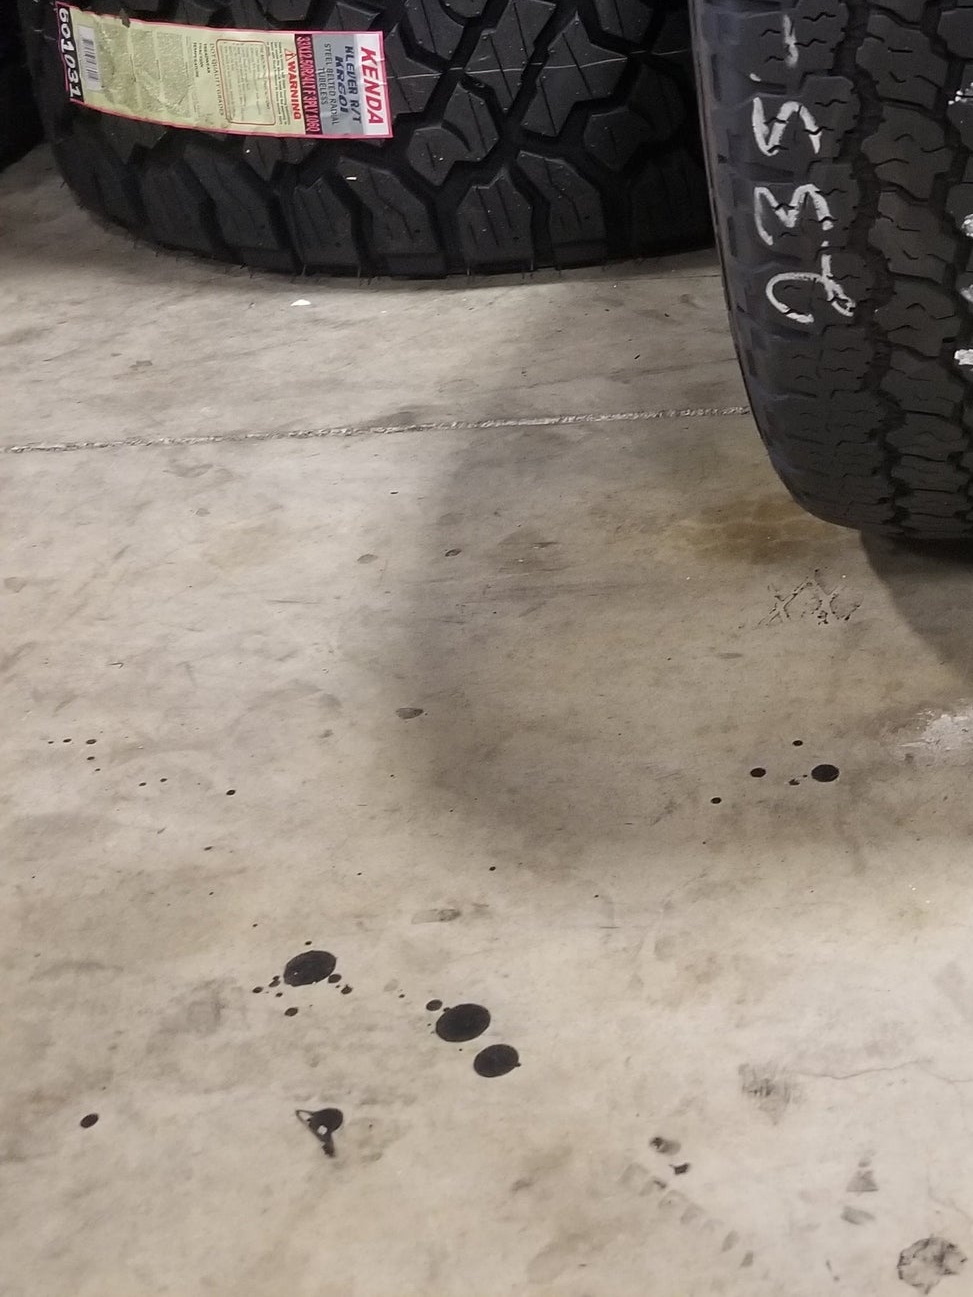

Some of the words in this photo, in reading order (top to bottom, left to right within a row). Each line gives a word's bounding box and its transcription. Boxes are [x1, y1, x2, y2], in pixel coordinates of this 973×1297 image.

[58, 8, 82, 97] 601031
[324, 43, 333, 66] STEEL
[345, 46, 359, 95] KLEVER
[287, 61, 302, 120] WARNING
[318, 67, 328, 105] TUBELESS
[326, 68, 336, 97] BELTED
[360, 47, 384, 124] KENDA
[329, 99, 339, 125] RADIAL
[350, 100, 361, 124] R/T
